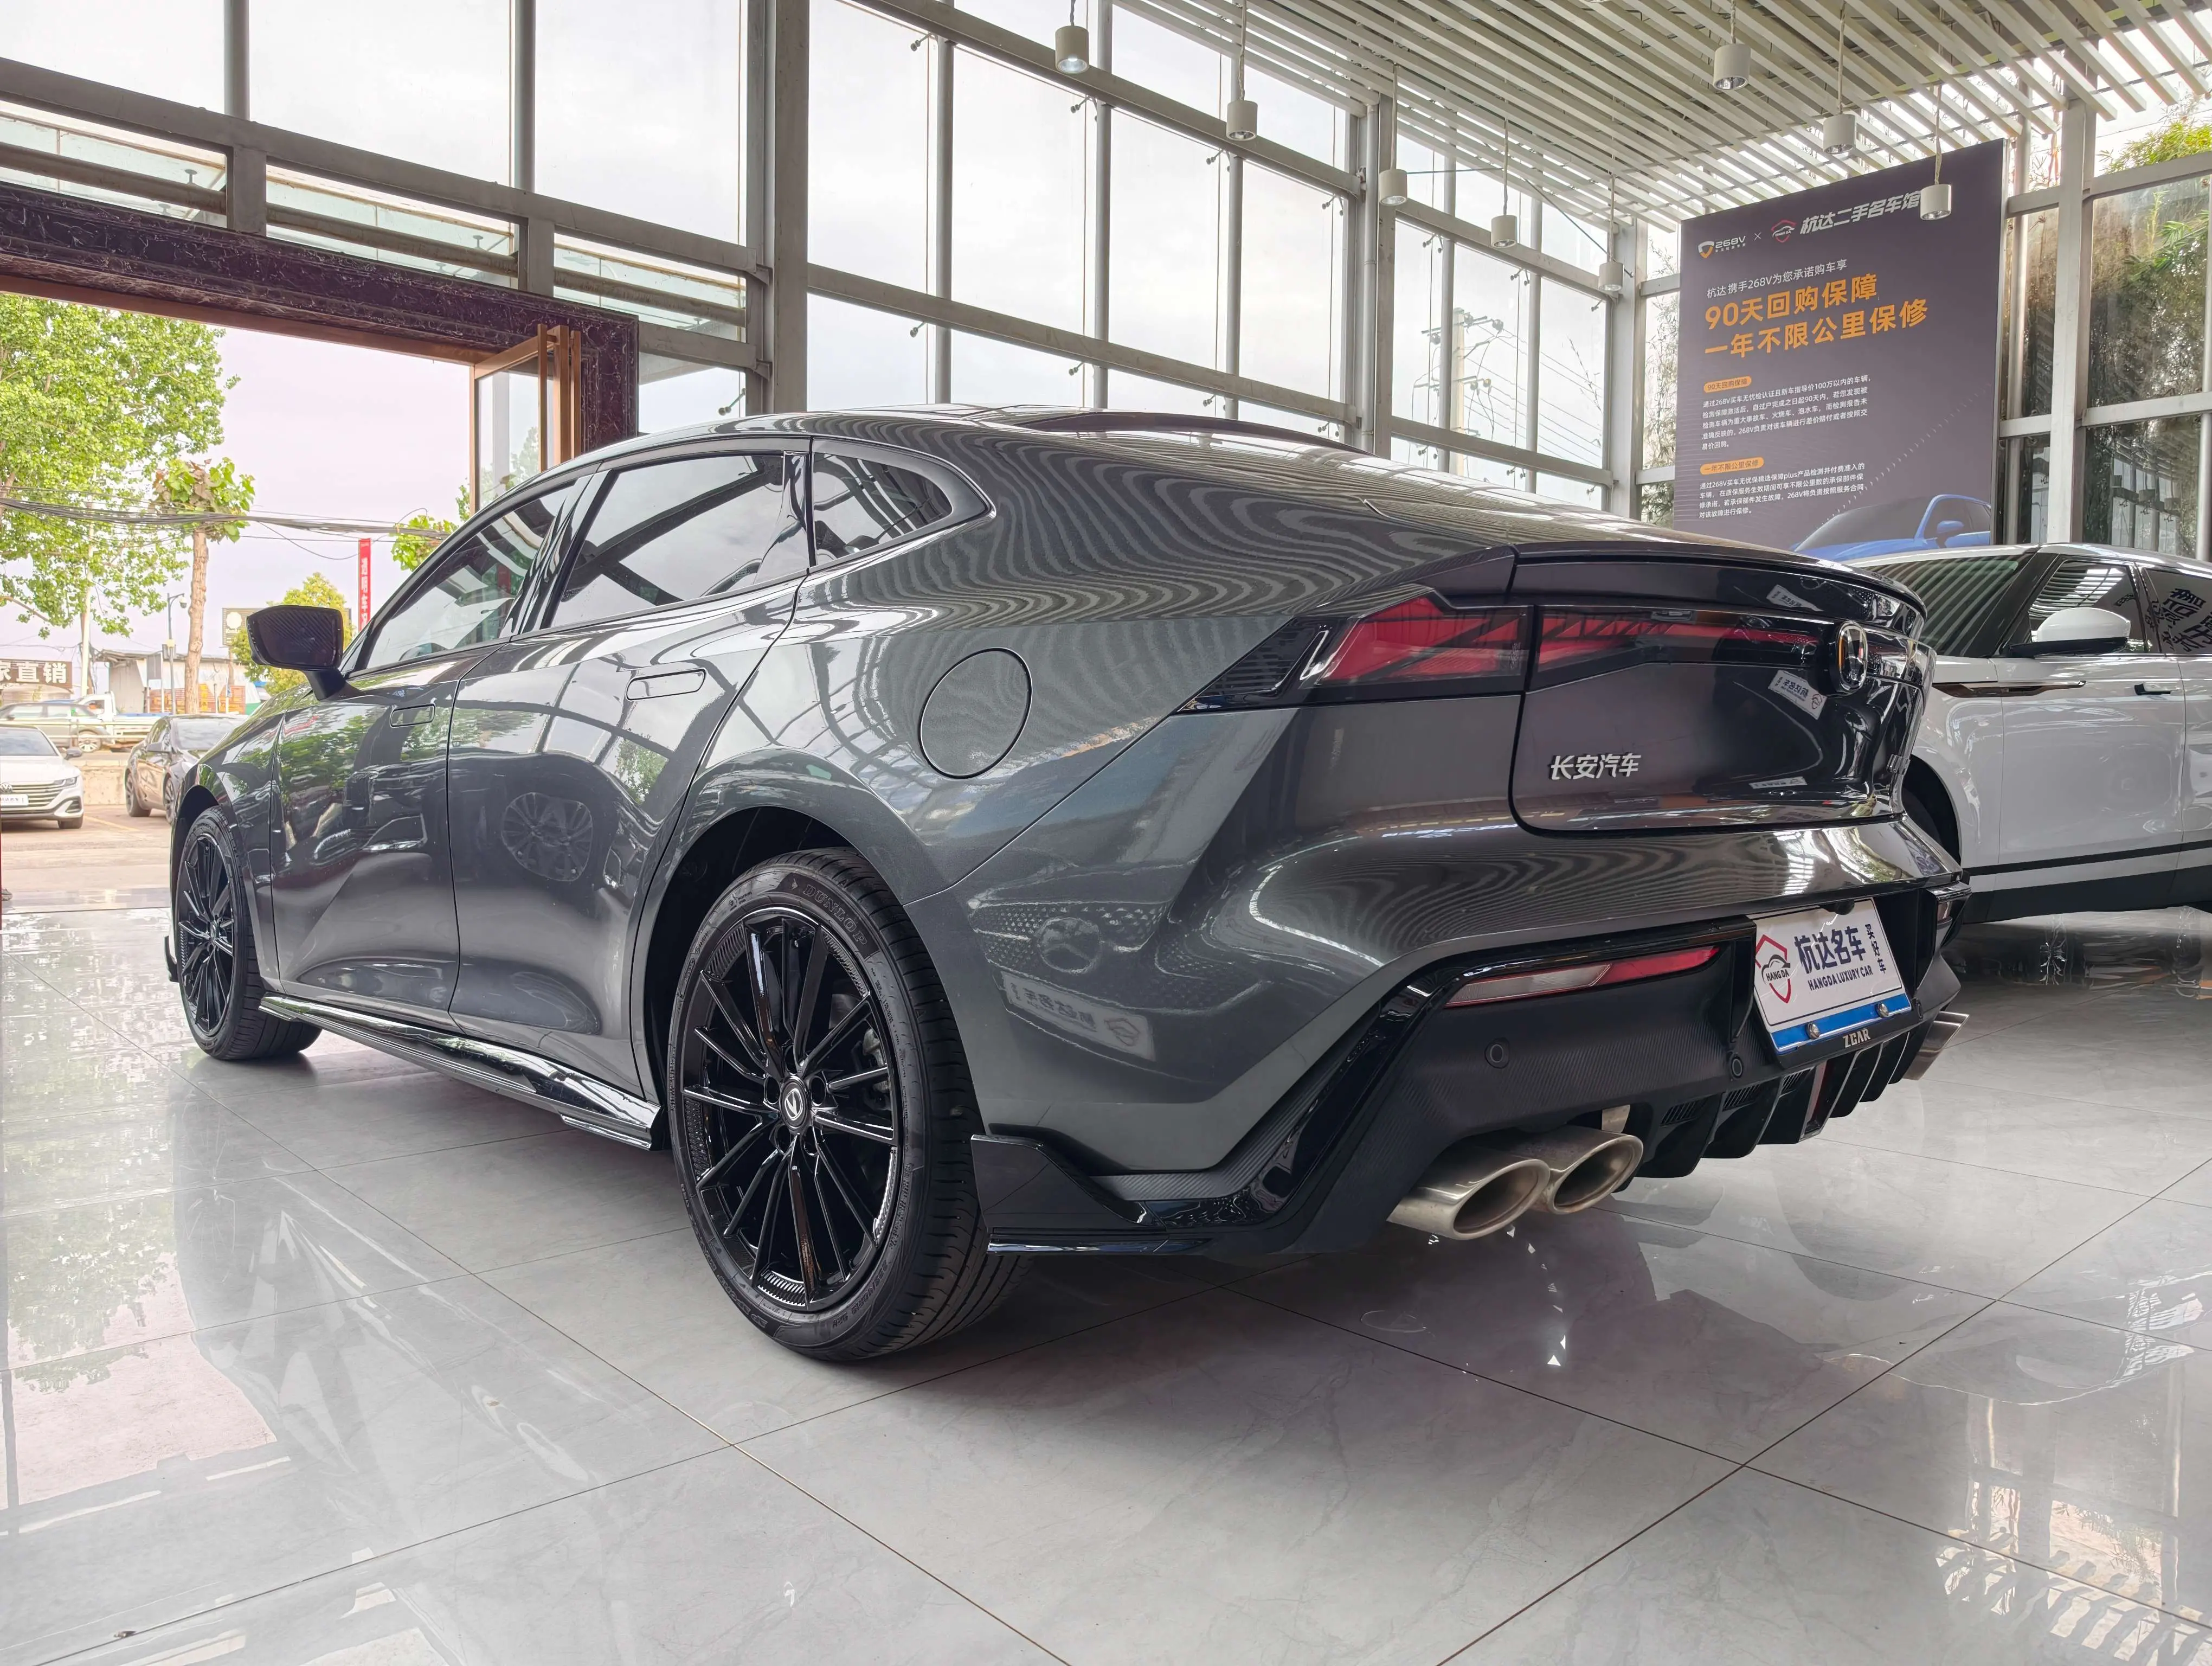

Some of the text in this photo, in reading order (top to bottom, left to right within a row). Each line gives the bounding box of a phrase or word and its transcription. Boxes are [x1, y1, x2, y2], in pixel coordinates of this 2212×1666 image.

[1800, 191, 1920, 234] 杭达二手名车馆
[1715, 235, 1746, 248] 268V
[1705, 273, 1877, 330] 90天回购保障
[1705, 299, 1928, 358] 一年不限公里保修
[1707, 379, 1747, 390] 90天回购保障
[1704, 459, 1758, 472] 一年不限公里保修
[1551, 753, 1642, 780] 长安汽车
[803, 884, 867, 945] DUNLOP
[1794, 926, 1866, 974] 杭达名车
[1865, 924, 1886, 974] 买好车
[1808, 965, 1873, 991] HANGDA LUXURY CAR
[1842, 1027, 1871, 1048] ZCAR
